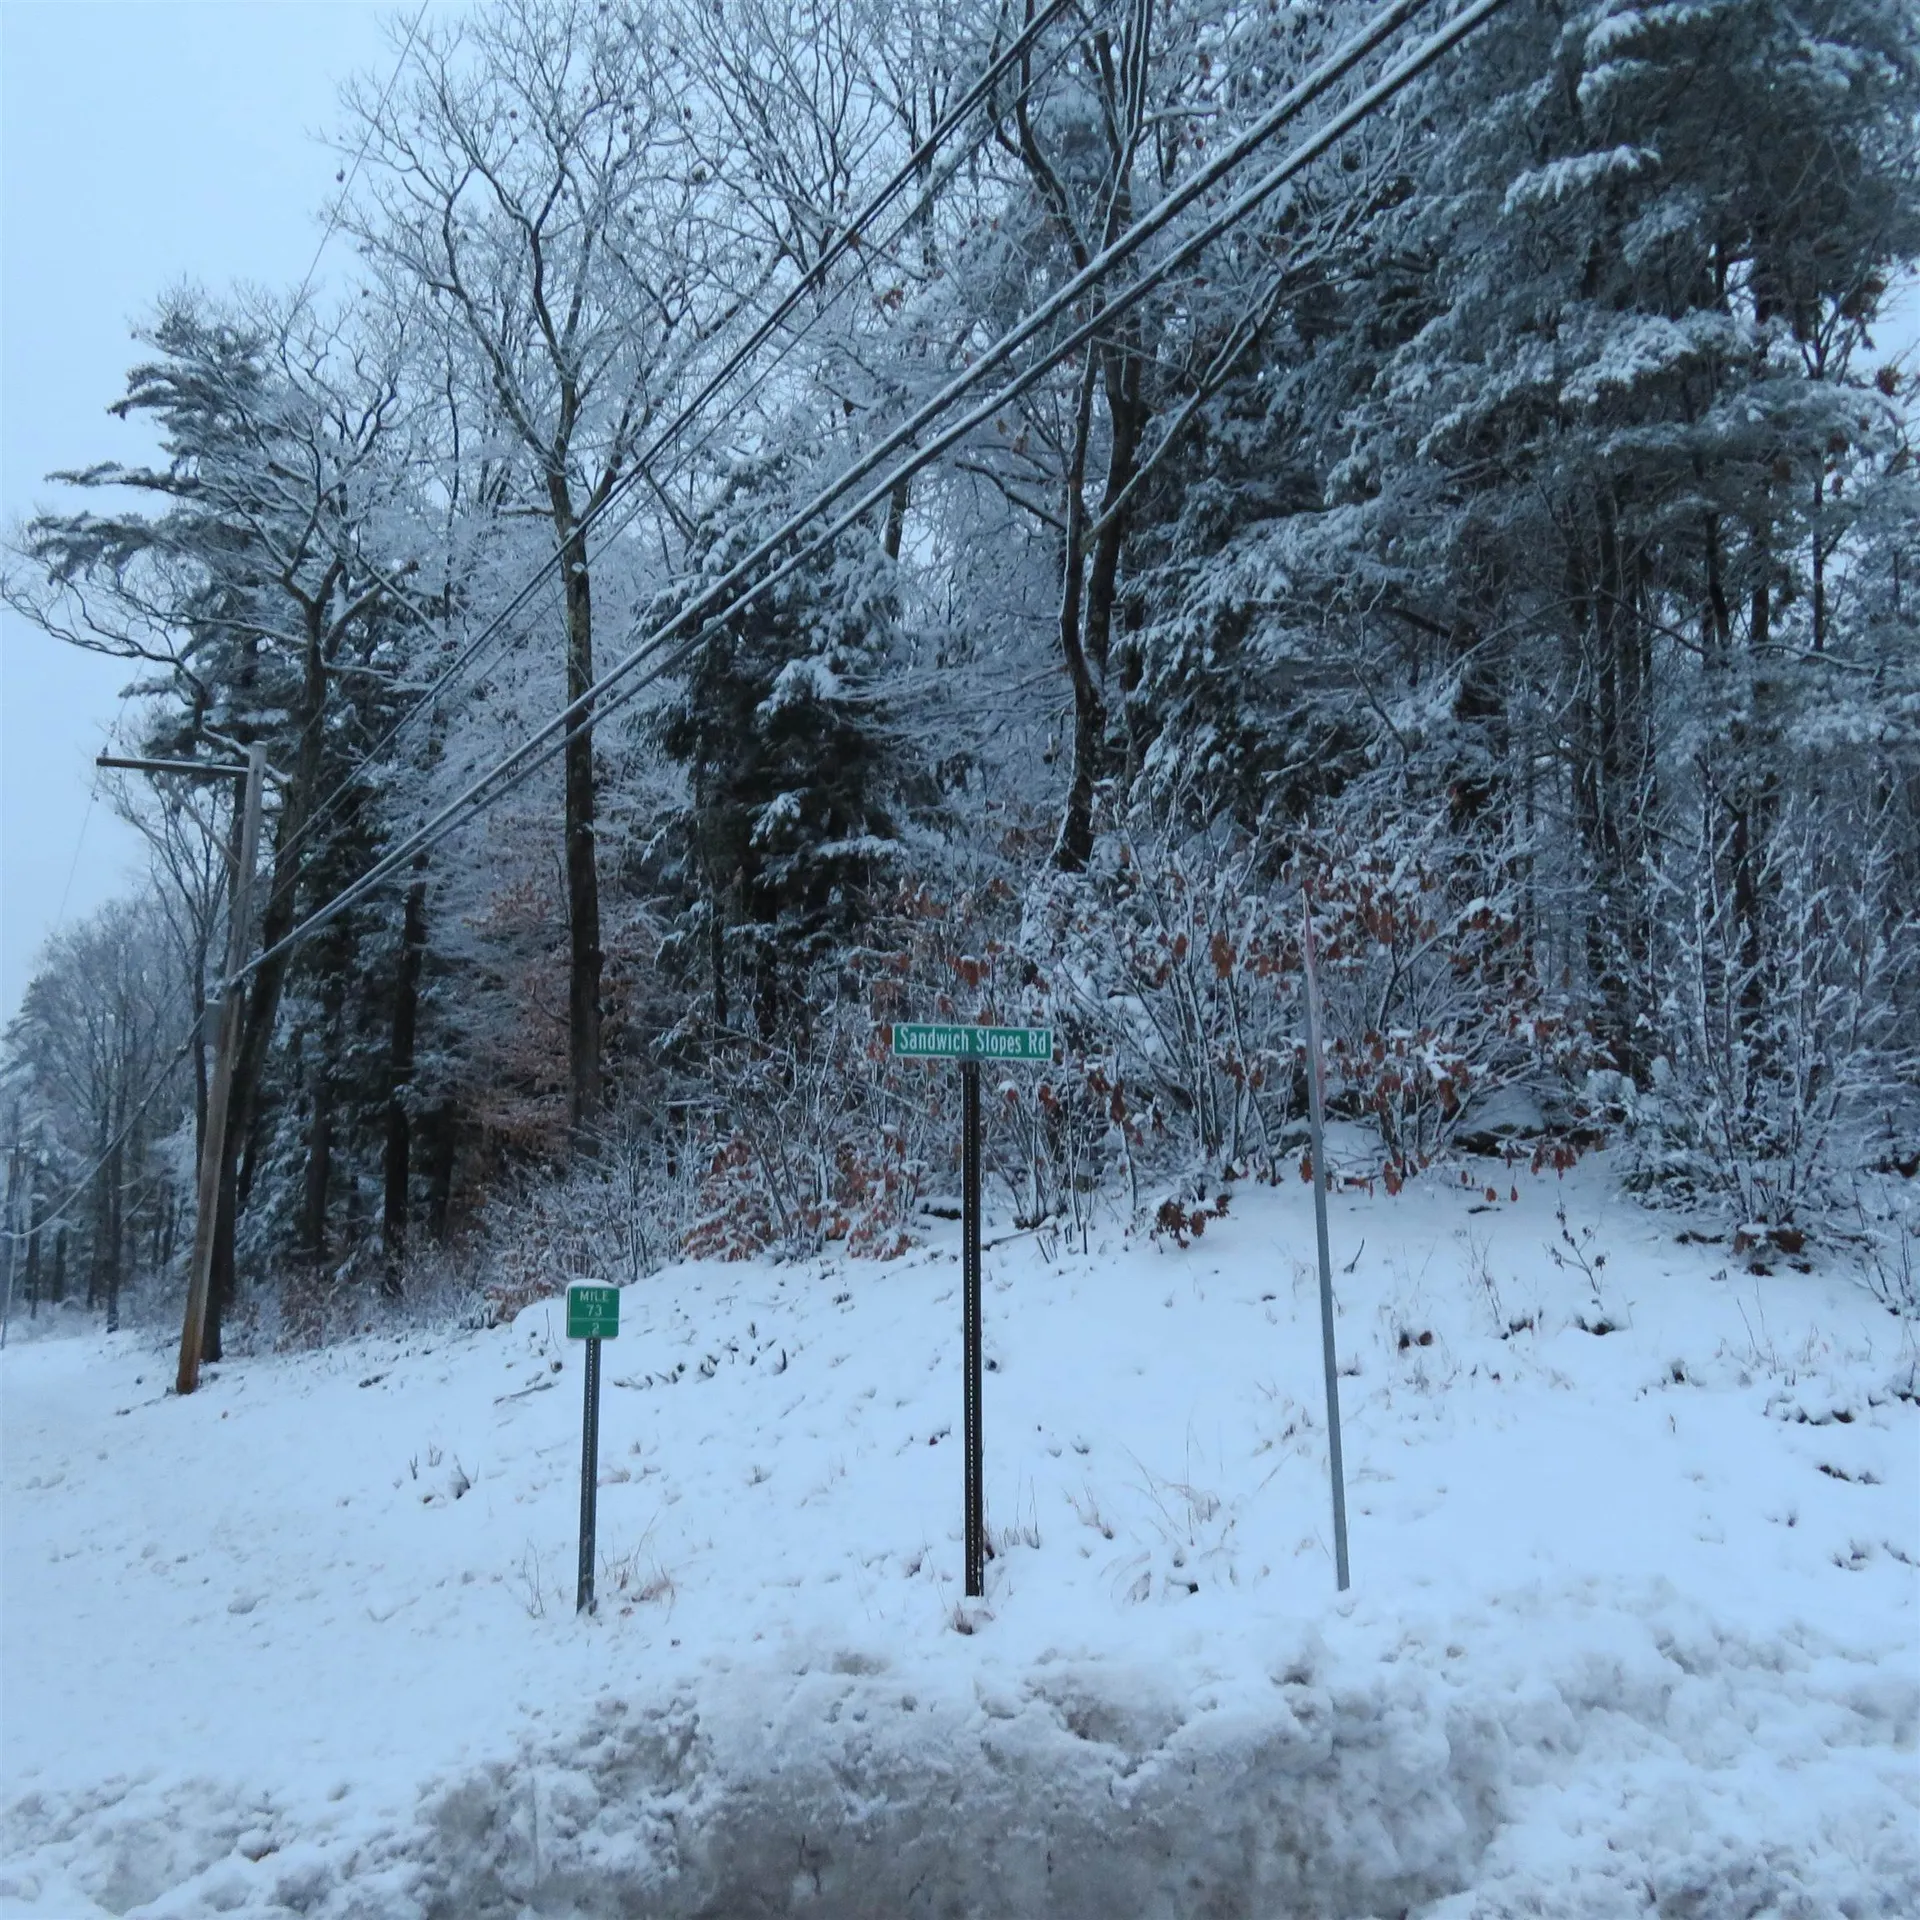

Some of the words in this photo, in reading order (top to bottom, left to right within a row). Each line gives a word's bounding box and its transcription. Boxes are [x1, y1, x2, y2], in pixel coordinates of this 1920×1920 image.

[900, 1027, 969, 1051] Sandwich
[976, 1029, 1022, 1055] Slopes
[1028, 1031, 1046, 1054] Rd
[580, 1290, 609, 1302] MILE
[586, 1304, 602, 1317] 73
